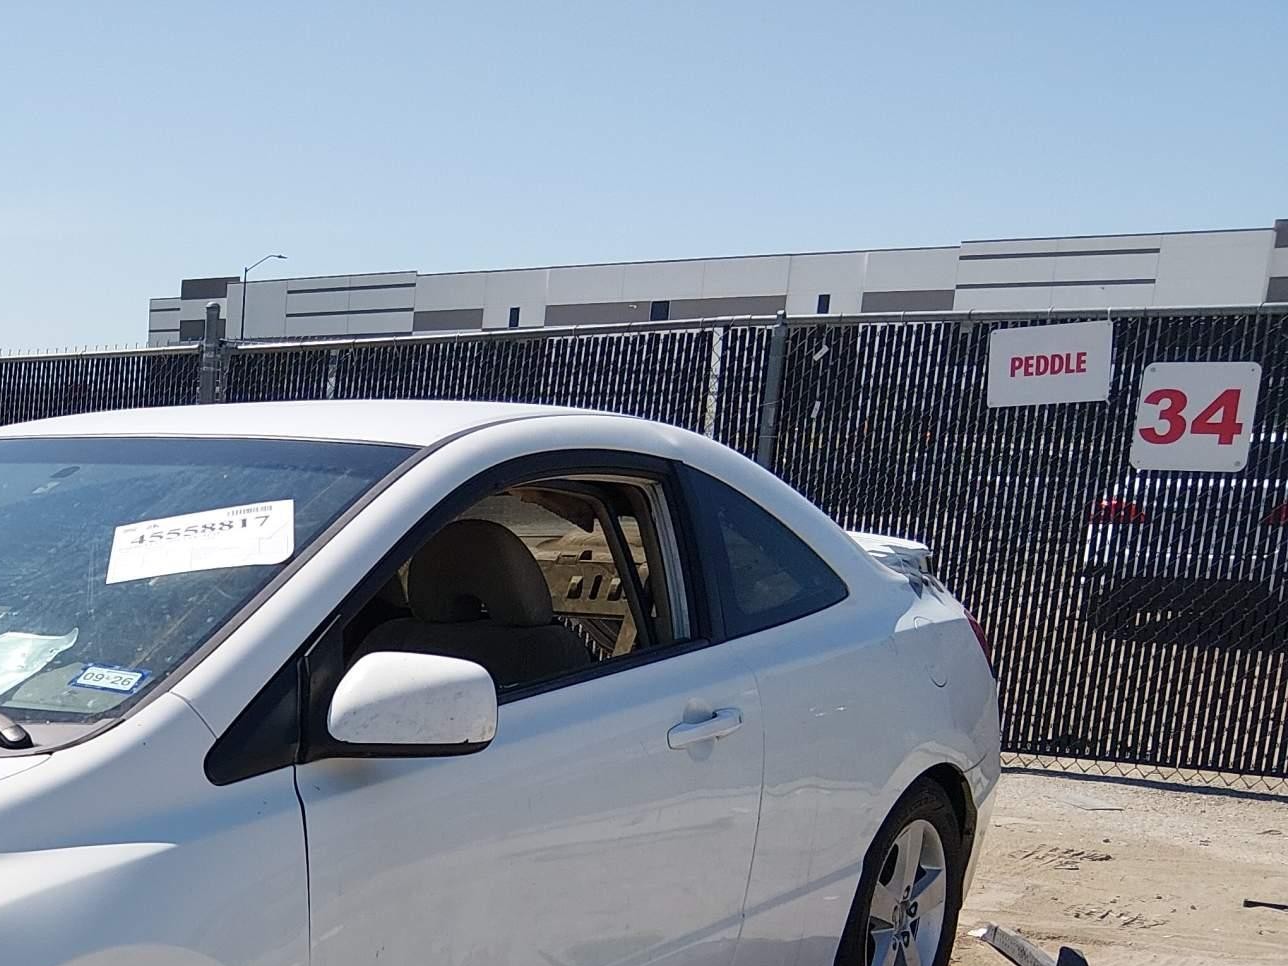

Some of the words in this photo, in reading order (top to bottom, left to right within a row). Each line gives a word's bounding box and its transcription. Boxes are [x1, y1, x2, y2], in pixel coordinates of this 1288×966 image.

[1010, 351, 1087, 377] PEDDLE
[1138, 388, 1244, 445] 34
[130, 515, 271, 545] 45558817
